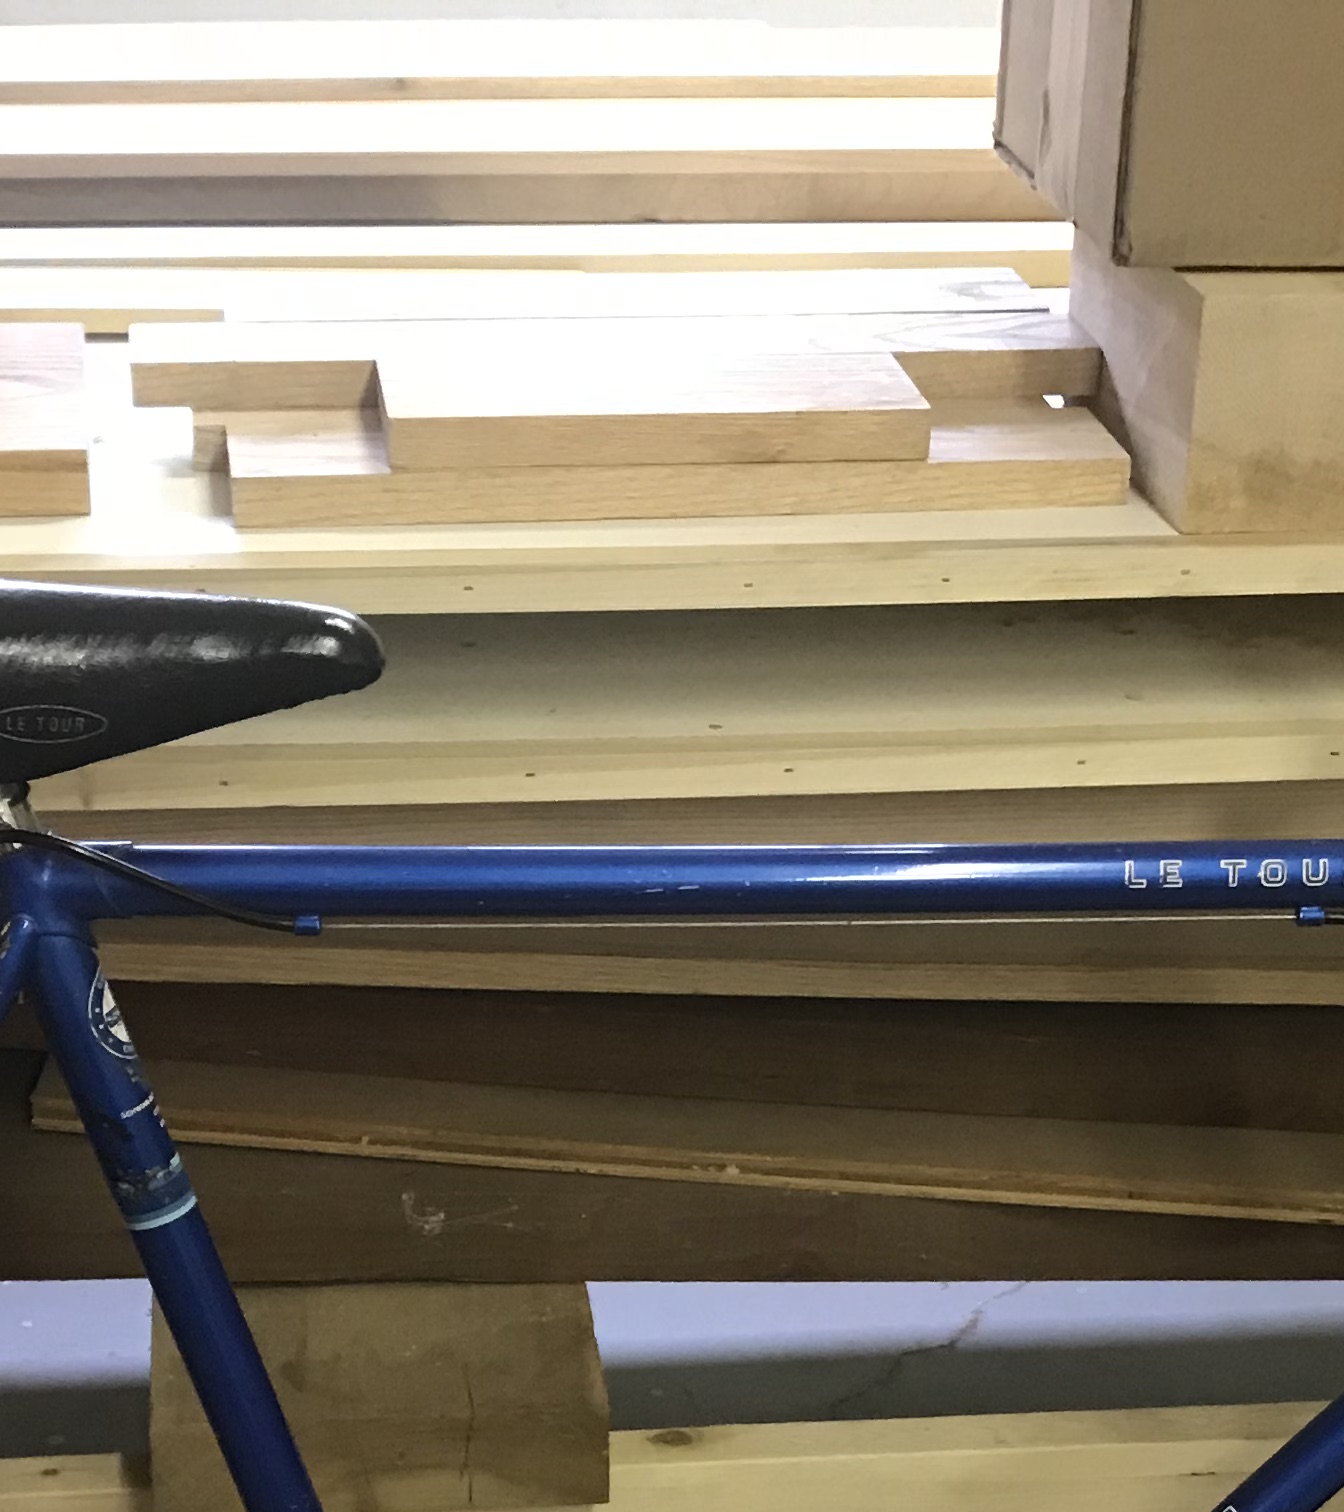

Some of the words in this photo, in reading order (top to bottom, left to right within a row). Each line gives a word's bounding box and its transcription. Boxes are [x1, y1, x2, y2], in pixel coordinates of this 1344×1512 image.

[6, 716, 25, 731] LE
[36, 716, 85, 732] TOUR
[1124, 860, 1184, 888] LE
